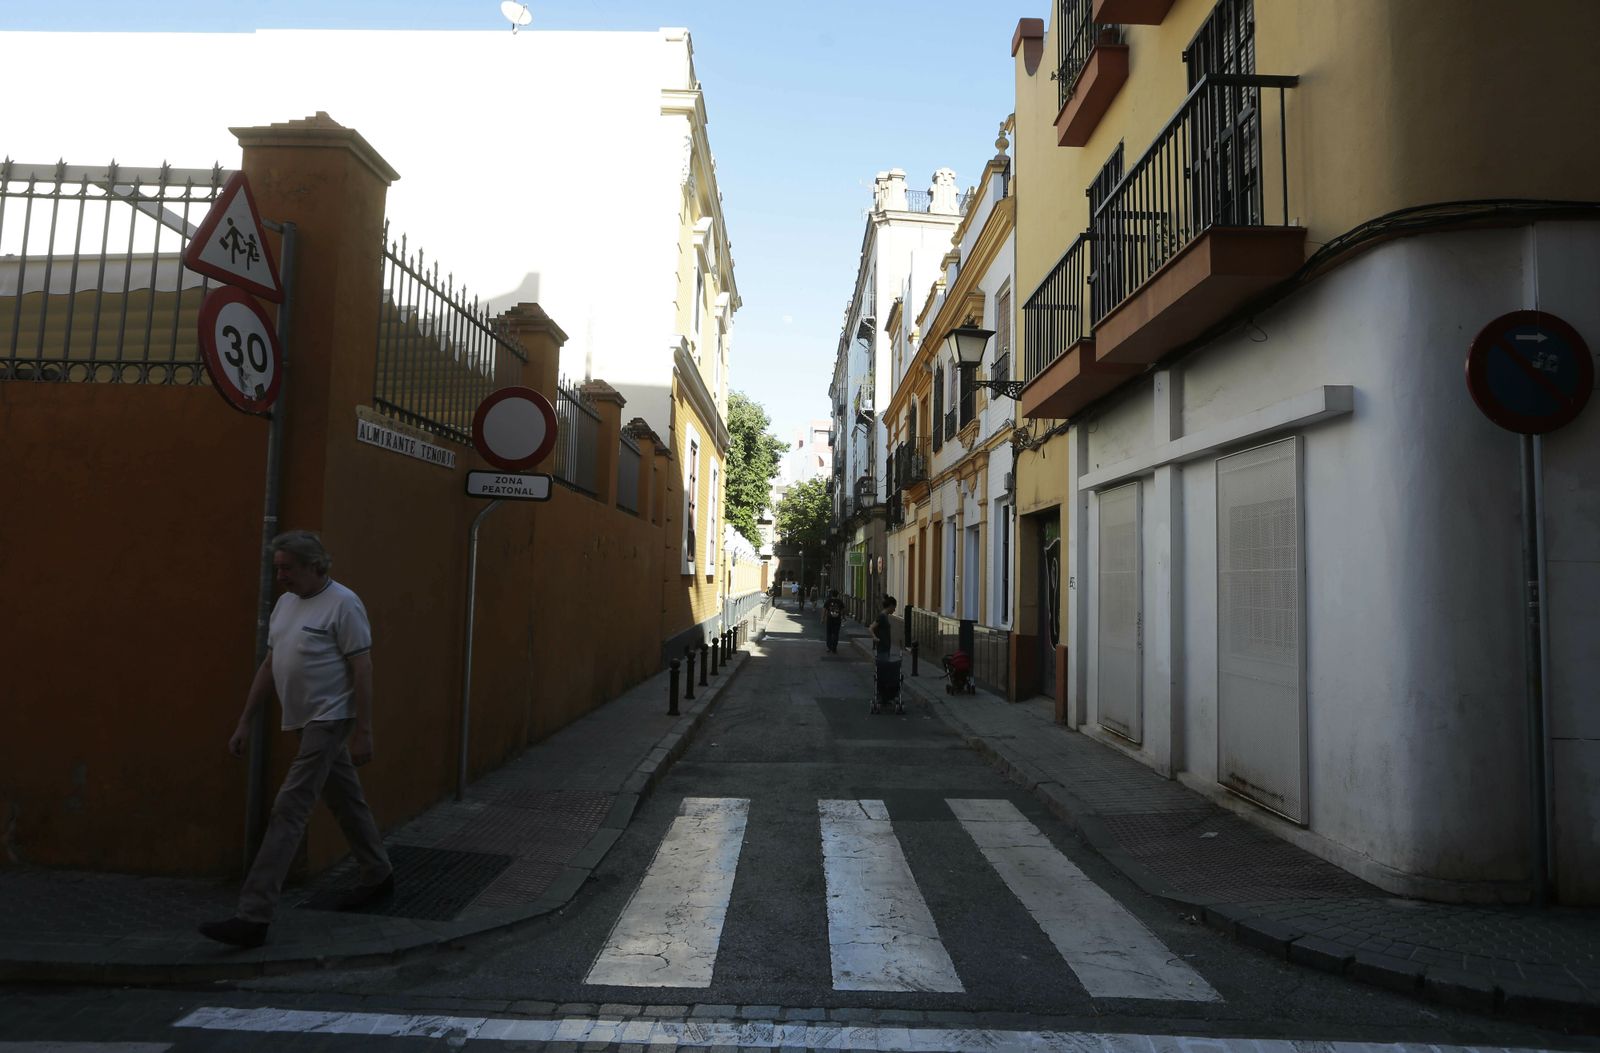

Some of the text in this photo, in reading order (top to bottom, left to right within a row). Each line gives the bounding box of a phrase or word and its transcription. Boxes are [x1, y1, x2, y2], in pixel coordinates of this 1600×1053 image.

[222, 325, 268, 373] 30
[359, 423, 456, 466] ALMIRANTE TENORIO
[482, 485, 534, 496] PEATONAL
[495, 476, 523, 485] ZONA
